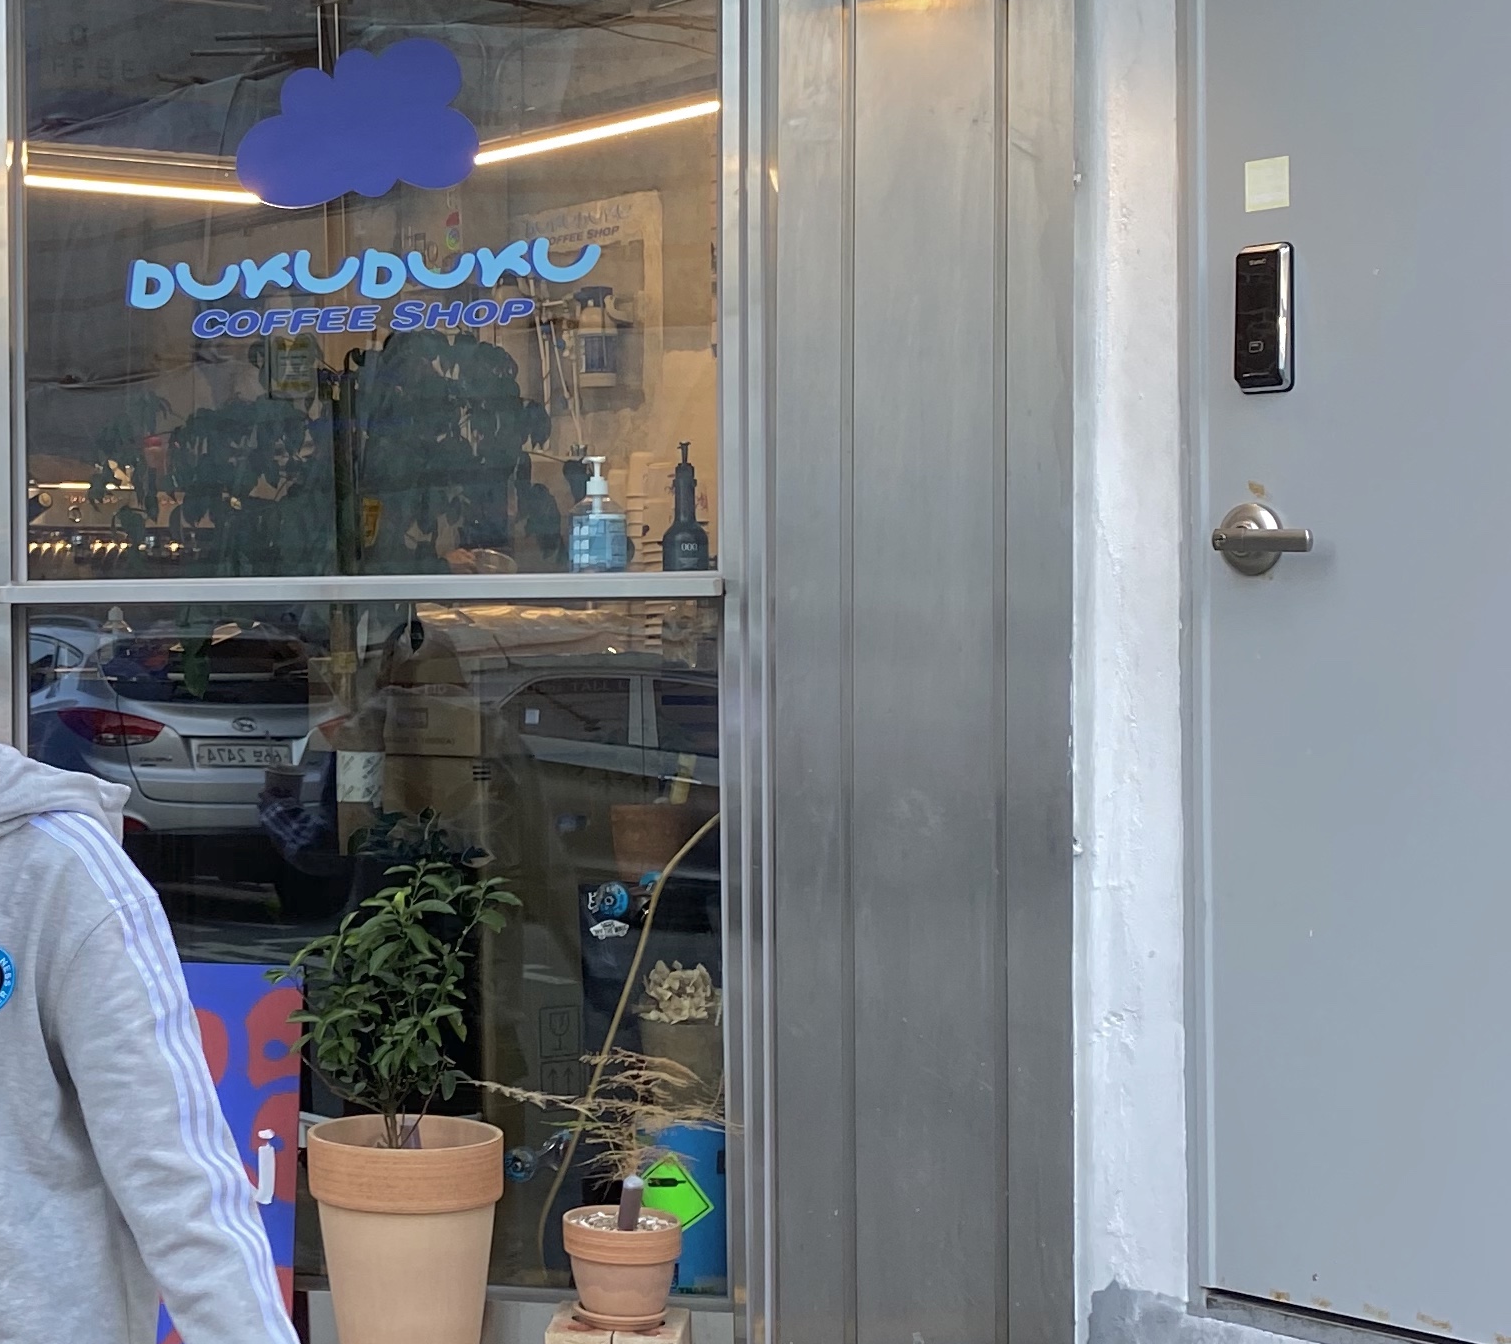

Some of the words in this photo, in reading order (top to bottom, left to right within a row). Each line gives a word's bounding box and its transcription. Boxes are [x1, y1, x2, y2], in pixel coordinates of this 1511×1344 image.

[128, 237, 601, 309] DUKUDUKU
[192, 304, 382, 339] COFFEE
[390, 298, 536, 331] SHOP
